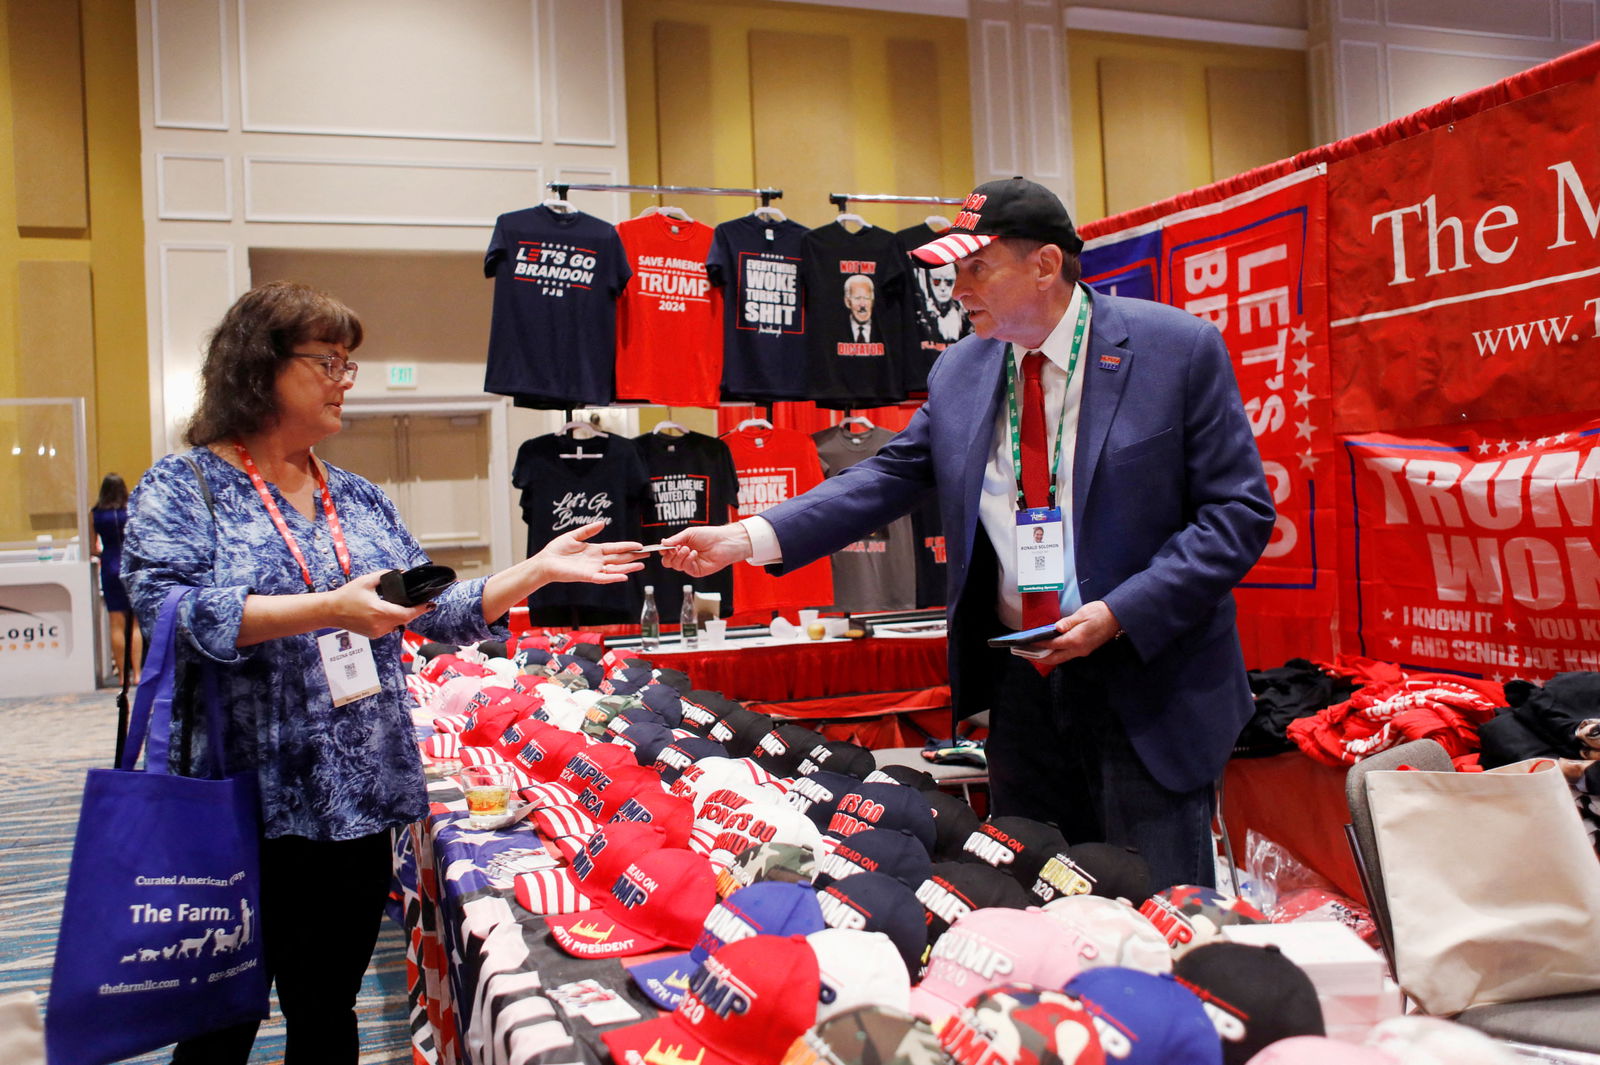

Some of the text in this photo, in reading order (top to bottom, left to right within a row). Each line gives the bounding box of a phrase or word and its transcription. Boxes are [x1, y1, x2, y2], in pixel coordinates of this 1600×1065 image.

[1371, 193, 1520, 287] The
[516, 247, 597, 270] LET'S GO
[638, 255, 664, 268] SAVE
[746, 258, 798, 275] EVERYTHING
[839, 260, 876, 274] NOT MY
[514, 262, 595, 285] BRANDON
[746, 269, 797, 293] WOKE
[542, 287, 564, 297] FJB
[637, 271, 711, 298] TRUMP
[658, 300, 686, 312] 2024
[745, 288, 796, 305] TURNS TO
[745, 301, 796, 326] SHIT
[837, 342, 885, 356] DICTATOR
[1238, 243, 1290, 439] LET'S
[659, 491, 682, 503] VOTED
[738, 482, 788, 503] WOKE
[552, 492, 613, 515] Let's Go
[655, 501, 698, 521] TRUMP
[552, 507, 613, 531] Brandon
[1403, 606, 1494, 634] I KNOW IT
[1528, 616, 1600, 641] YOU K
[1411, 635, 1449, 659] AND
[1451, 639, 1520, 668] SENILE
[1523, 646, 1561, 671] JOE
[857, 799, 885, 824] GO
[749, 819, 778, 843] GO
[1007, 838, 1026, 853] ON
[860, 857, 879, 873] ON
[135, 874, 177, 886] Curated
[178, 875, 228, 887] American
[642, 878, 659, 893] ON
[130, 903, 230, 923] The Farm
[571, 939, 635, 954] PRESIDENT
[99, 978, 180, 995] thefarmllc.com
